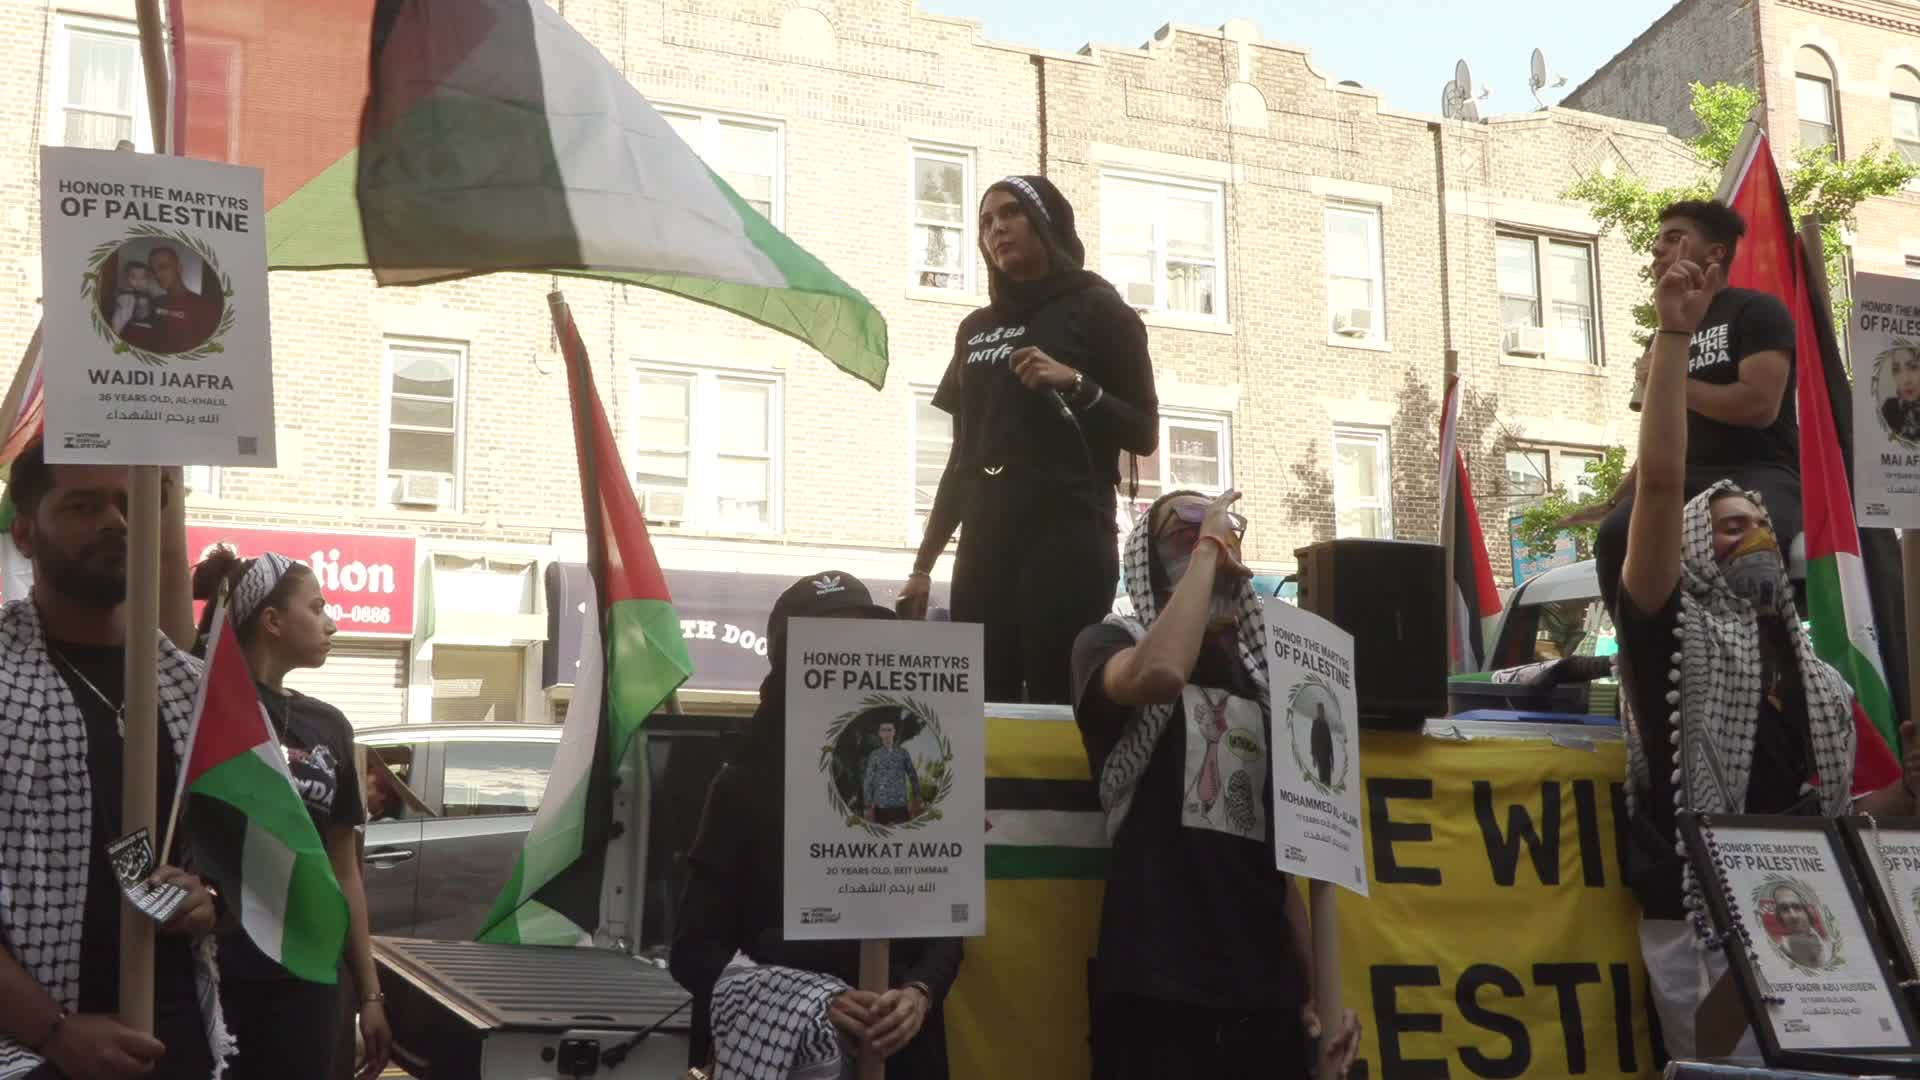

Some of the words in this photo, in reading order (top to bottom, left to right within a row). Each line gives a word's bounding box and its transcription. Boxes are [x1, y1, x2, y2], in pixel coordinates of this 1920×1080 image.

[59, 179, 125, 197] HONOR
[130, 184, 164, 200] THE
[168, 188, 249, 211] MARTYRS
[60, 197, 97, 218] OF
[105, 199, 249, 233] PALESTINE
[1860, 314, 1879, 331] OF
[1699, 335, 1729, 354] THE
[1689, 349, 1731, 373] FADA
[88, 368, 154, 386] WAJDI
[160, 371, 235, 391] JAAFRA
[114, 393, 147, 403] YEARS
[1272, 624, 1302, 646] HONOR
[1303, 637, 1321, 654] THE
[803, 652, 861, 666] HONOR
[865, 653, 896, 667] THE
[899, 654, 970, 670] MARTYRS
[1274, 640, 1291, 660] OF
[1293, 647, 1351, 690] PALESTINE
[804, 669, 837, 690] OF
[843, 670, 969, 693] PALESTINE
[1280, 788, 1332, 815] MOHAMMED
[809, 843, 903, 859] SHAWKAT
[907, 842, 963, 858] AWAD
[1719, 843, 1752, 853] HONOR
[1752, 843, 1773, 854] THE
[840, 866, 870, 876] YEARS
[1723, 855, 1742, 871] OF
[1745, 855, 1825, 872] PALESTINE
